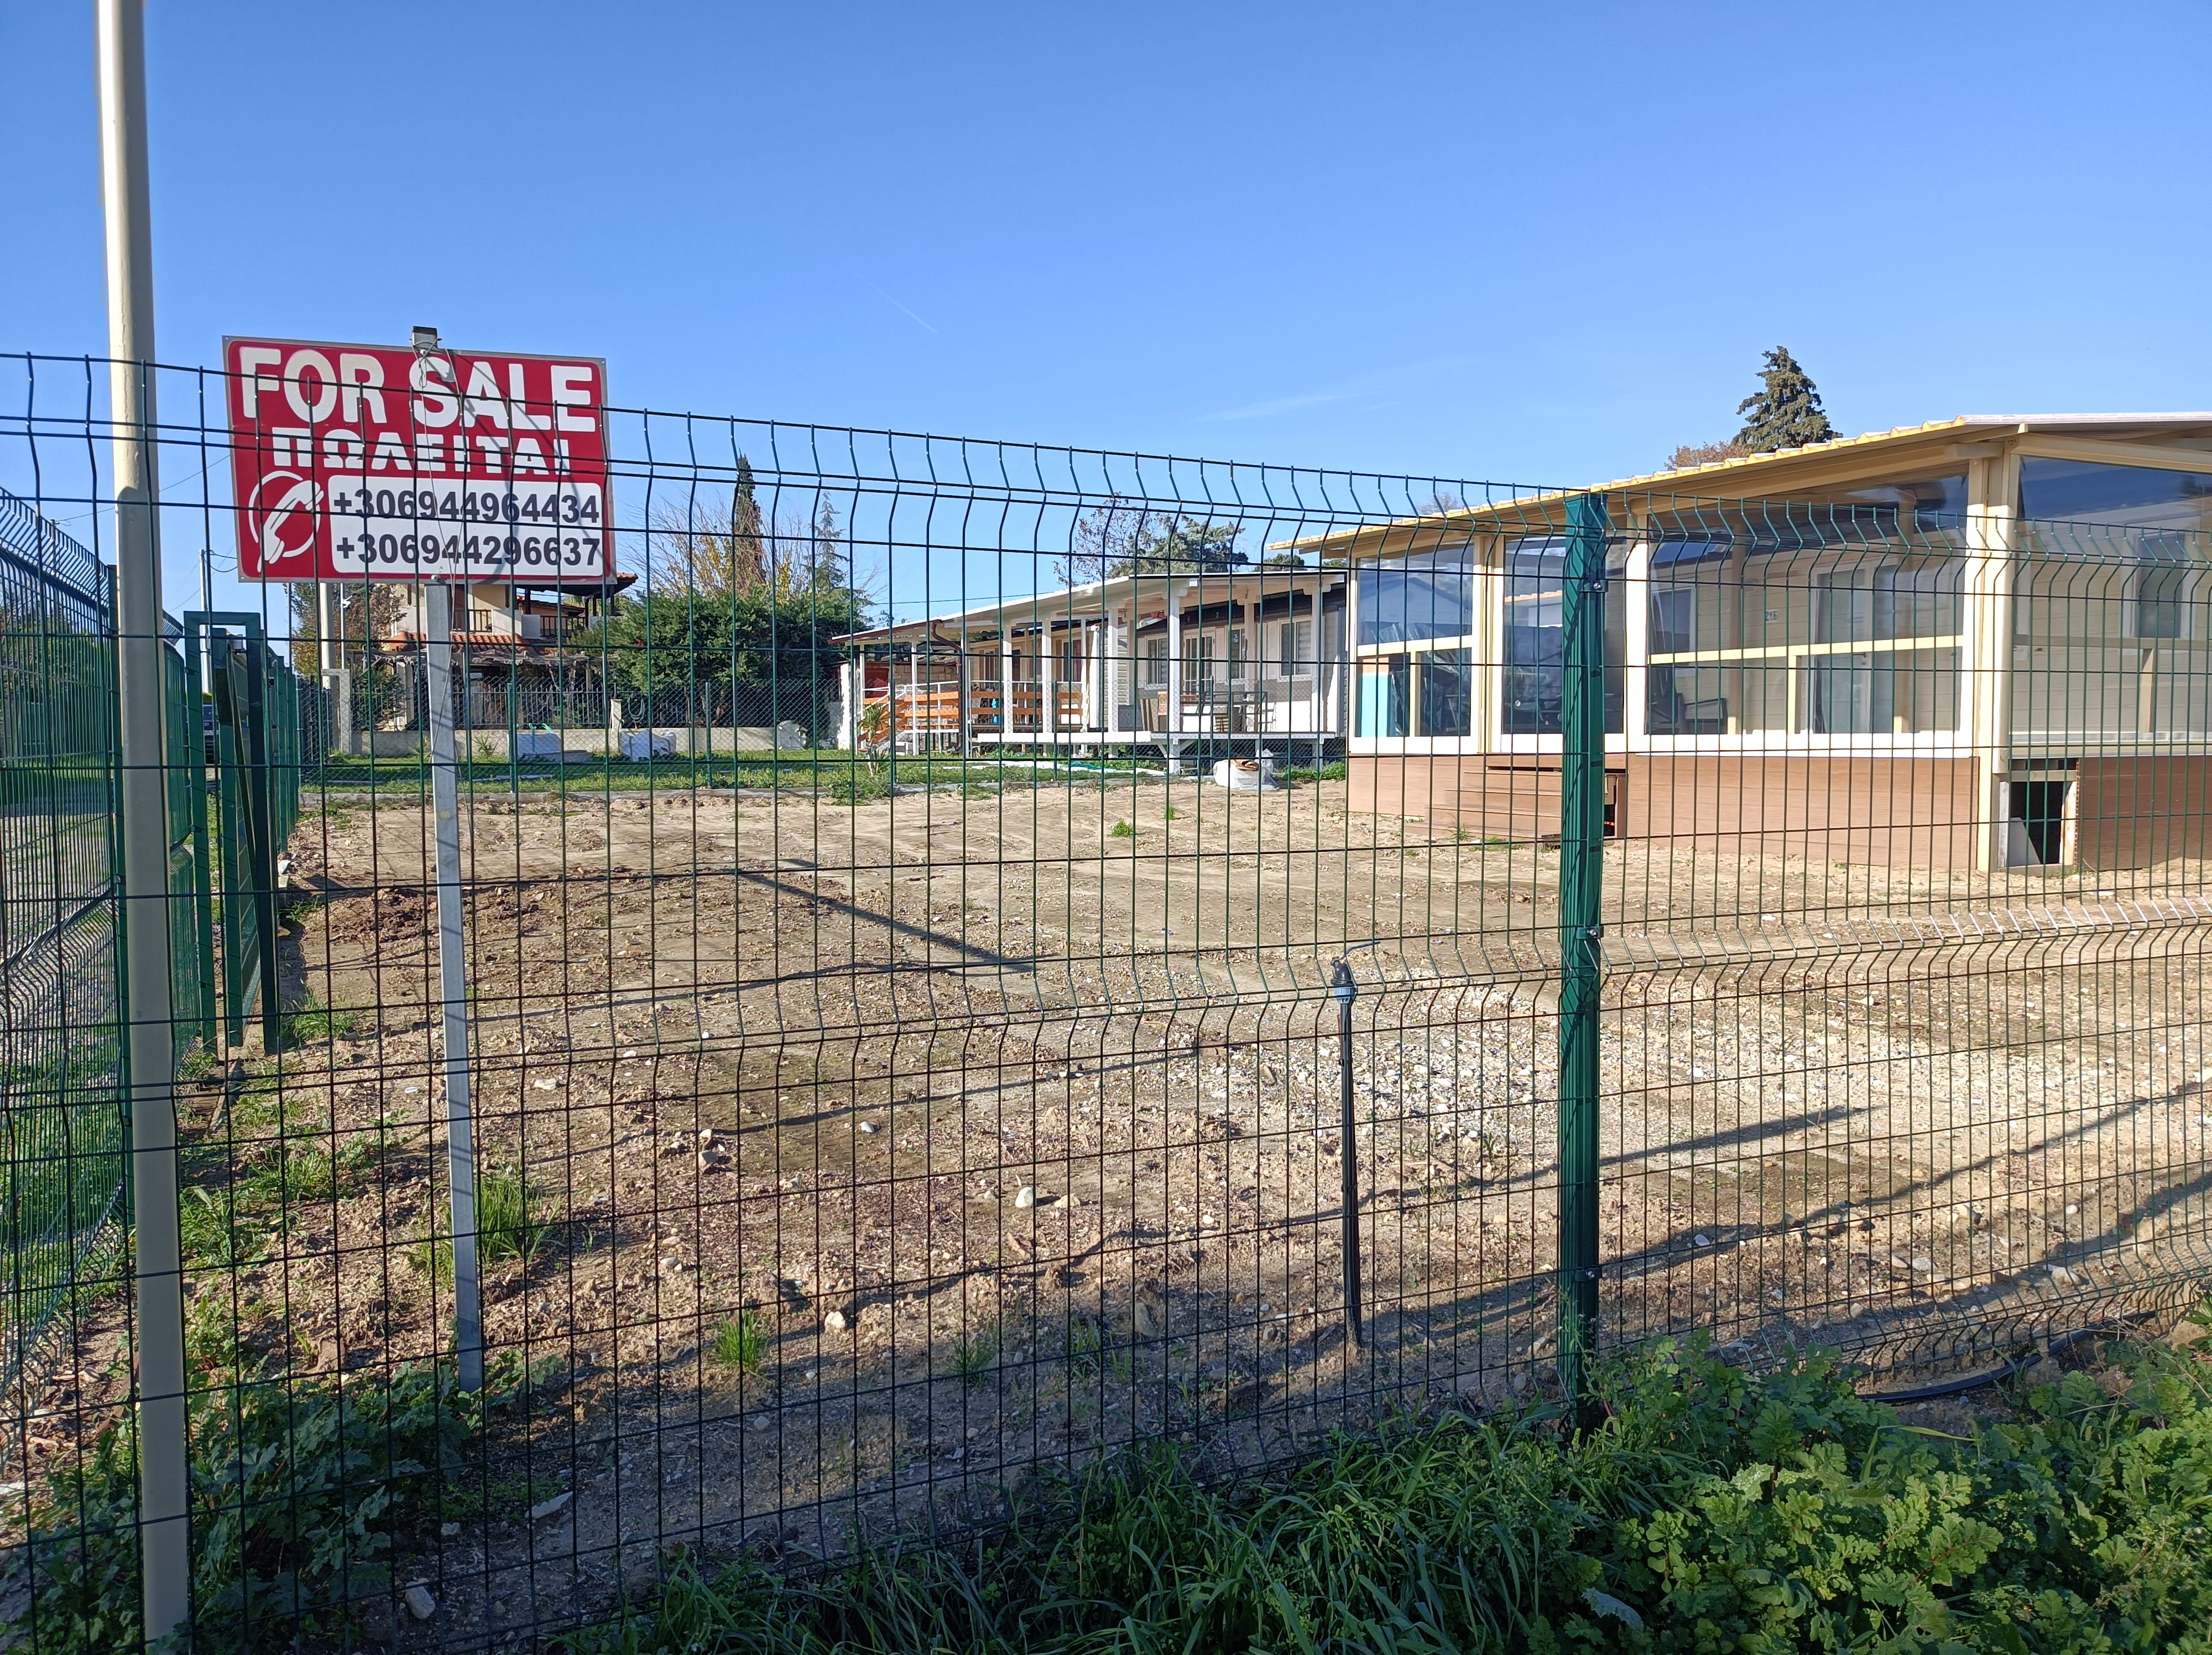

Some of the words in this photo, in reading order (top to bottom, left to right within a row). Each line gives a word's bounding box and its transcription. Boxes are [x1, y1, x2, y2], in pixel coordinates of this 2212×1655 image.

[239, 346, 388, 424] FOR
[409, 355, 596, 433] SALE
[272, 426, 571, 476] ΠΩΛΕΙΤΑΙ
[333, 488, 599, 523] +306944964434
[336, 533, 601, 566] +306944296637
